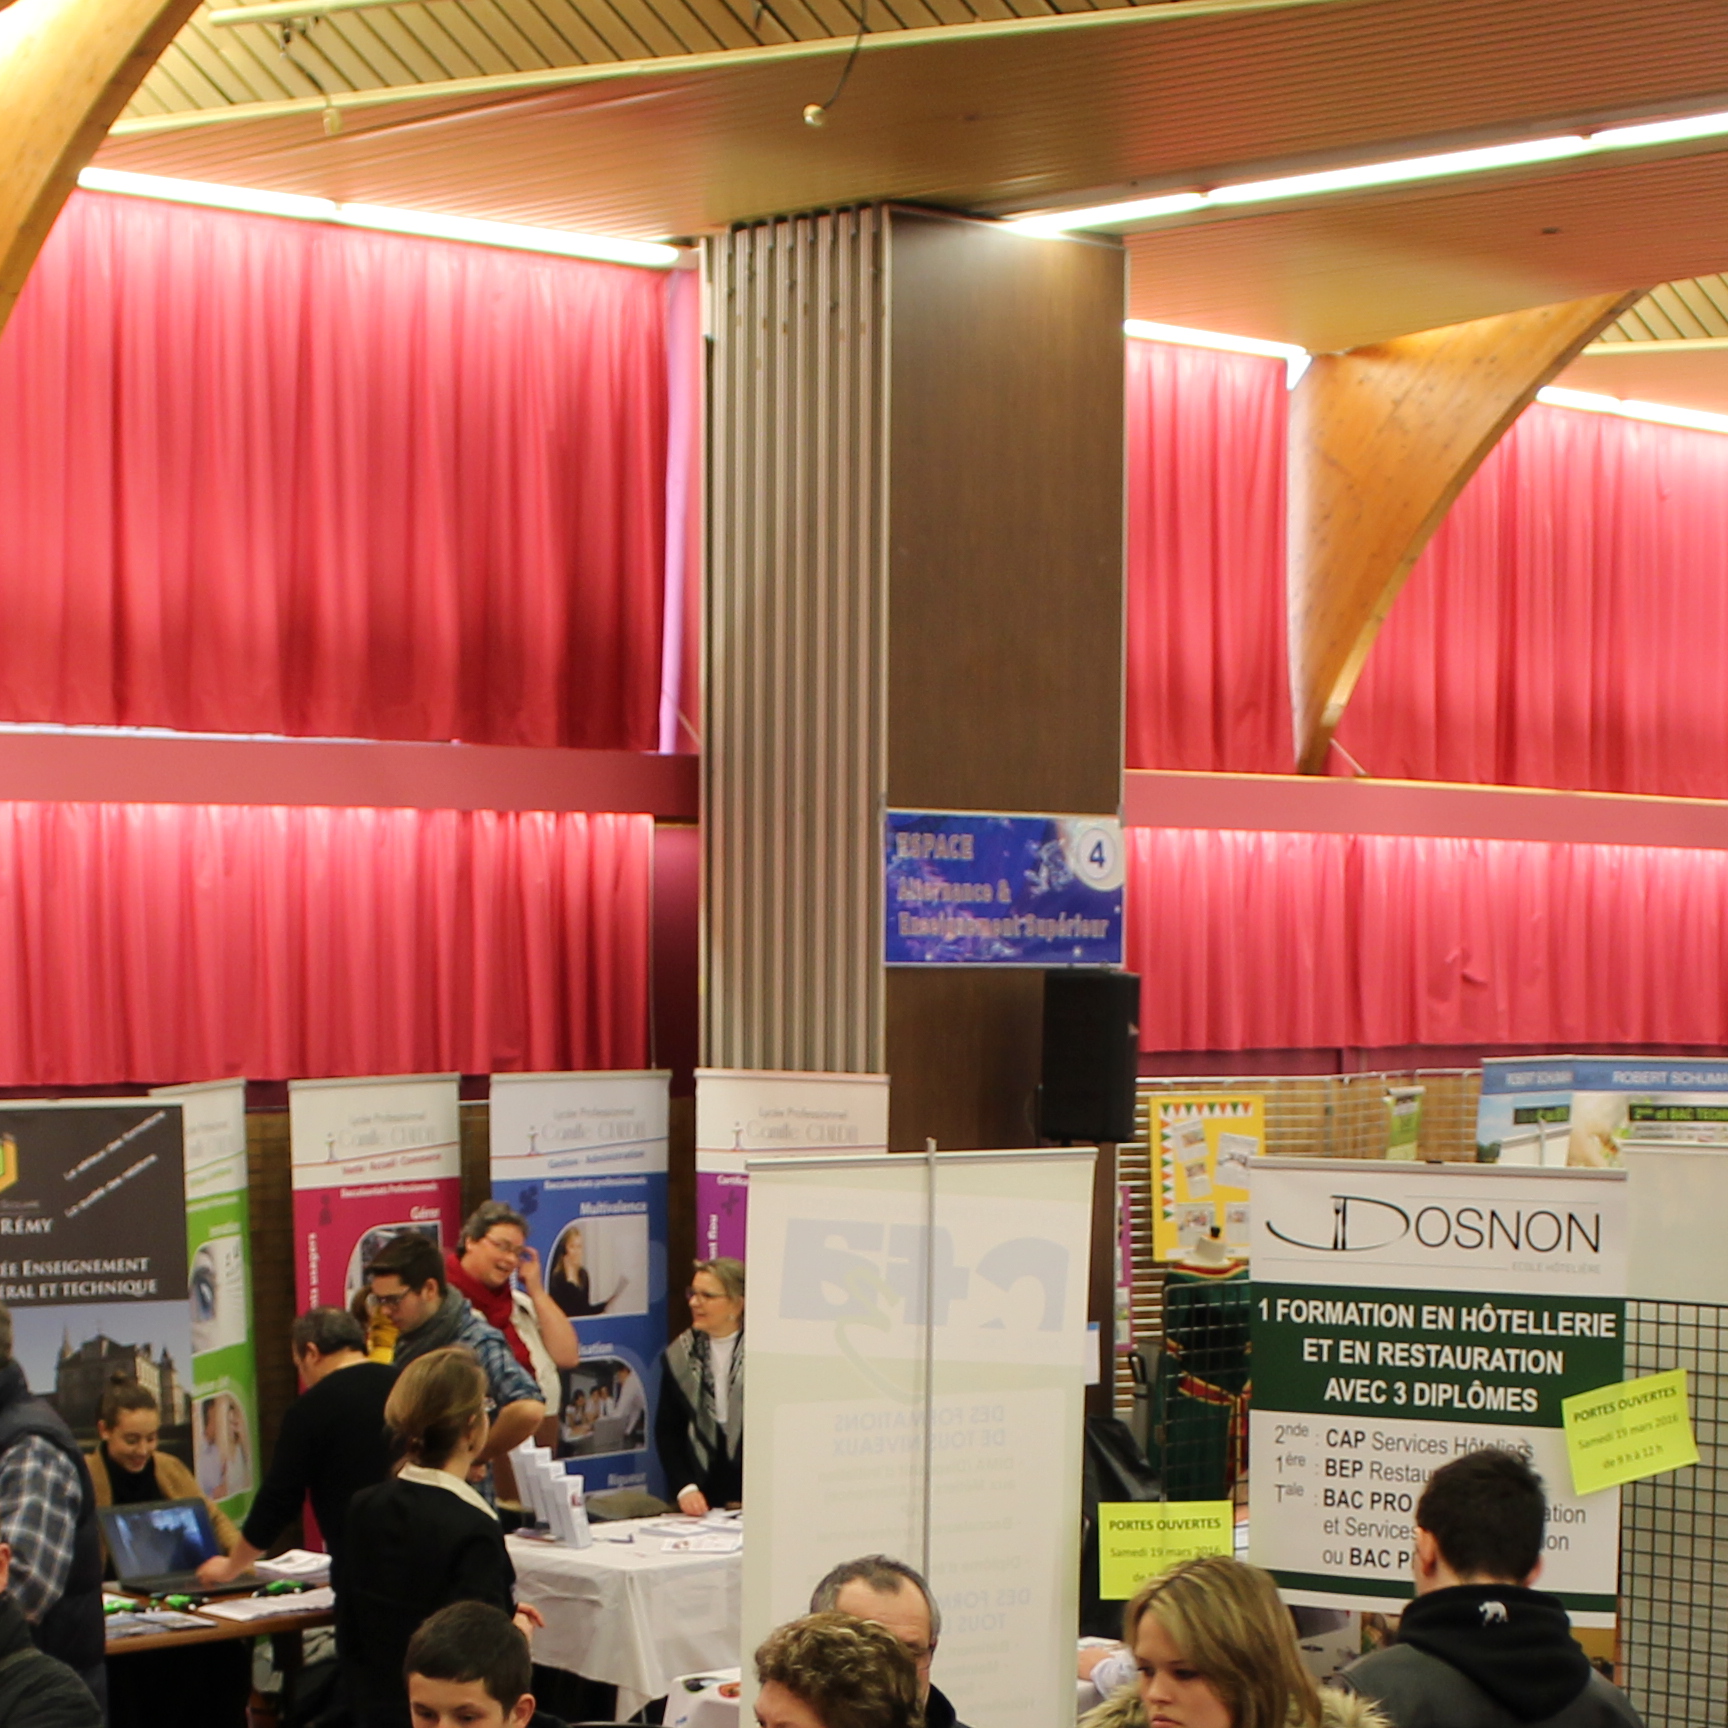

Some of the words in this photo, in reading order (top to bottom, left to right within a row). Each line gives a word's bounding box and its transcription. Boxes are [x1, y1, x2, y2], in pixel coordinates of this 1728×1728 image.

[895, 832, 974, 861] ESPACE
[1090, 841, 1105, 868] 4
[22, 1257, 150, 1276] ENSEIGNEMENT
[39, 1283, 60, 1299] ET
[63, 1279, 159, 1298] TECHNIQUE
[1258, 1298, 1269, 1321] 1
[1276, 1299, 1413, 1329] FORMATION
[1422, 1305, 1453, 1330] EN
[1460, 1303, 1616, 1338] HÔTELLERIE
[1303, 1338, 1330, 1362] ET
[1339, 1340, 1370, 1364] EN
[1377, 1341, 1563, 1374] RESTAURATION
[1324, 1377, 1385, 1404] AVEC
[1393, 1381, 1407, 1404] 3
[1414, 1379, 1538, 1412] DIPLÔMES
[1574, 1403, 1616, 1423] PORTES
[1618, 1386, 1677, 1411] OUVERTES
[1326, 1429, 1365, 1448] CAP
[1373, 1432, 1448, 1454] Services
[1578, 1431, 1614, 1449] Samedi
[1630, 1423, 1653, 1435] mars
[1326, 1458, 1363, 1478] BEP
[1323, 1489, 1363, 1509] BAC
[1369, 1492, 1412, 1512] PRO
[1109, 1519, 1154, 1531] PORTES
[1157, 1518, 1221, 1530] OUVERTES
[1323, 1519, 1341, 1535] et
[1323, 1549, 1343, 1565] ou
[1349, 1547, 1391, 1568] BAC
